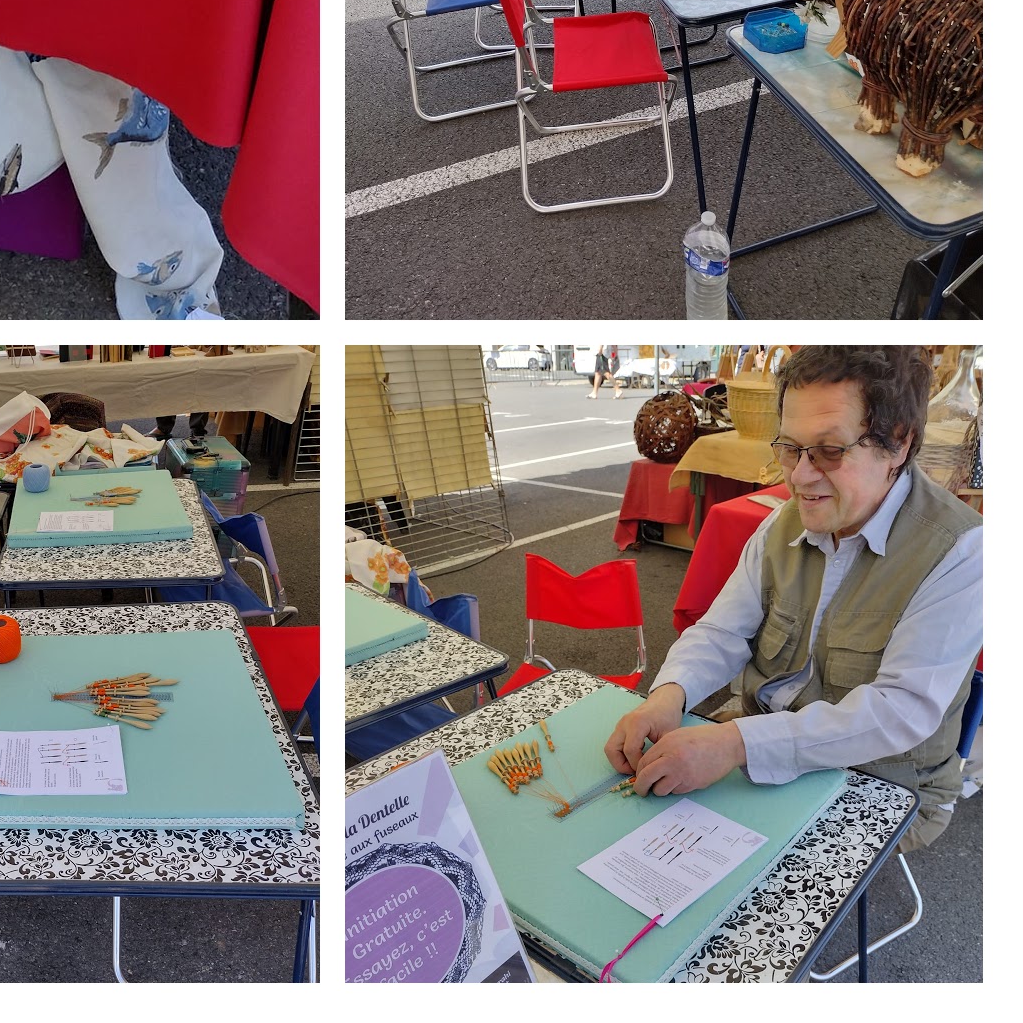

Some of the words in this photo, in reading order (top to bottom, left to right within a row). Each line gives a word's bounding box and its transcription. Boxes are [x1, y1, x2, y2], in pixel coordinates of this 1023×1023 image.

[345, 823, 358, 839] la
[358, 795, 410, 829] Dentelle
[350, 837, 373, 855] aux
[374, 811, 419, 843] fuseaux
[352, 907, 428, 960] Gratuite.
[416, 908, 455, 942] c'est
[425, 942, 439, 959] !!
